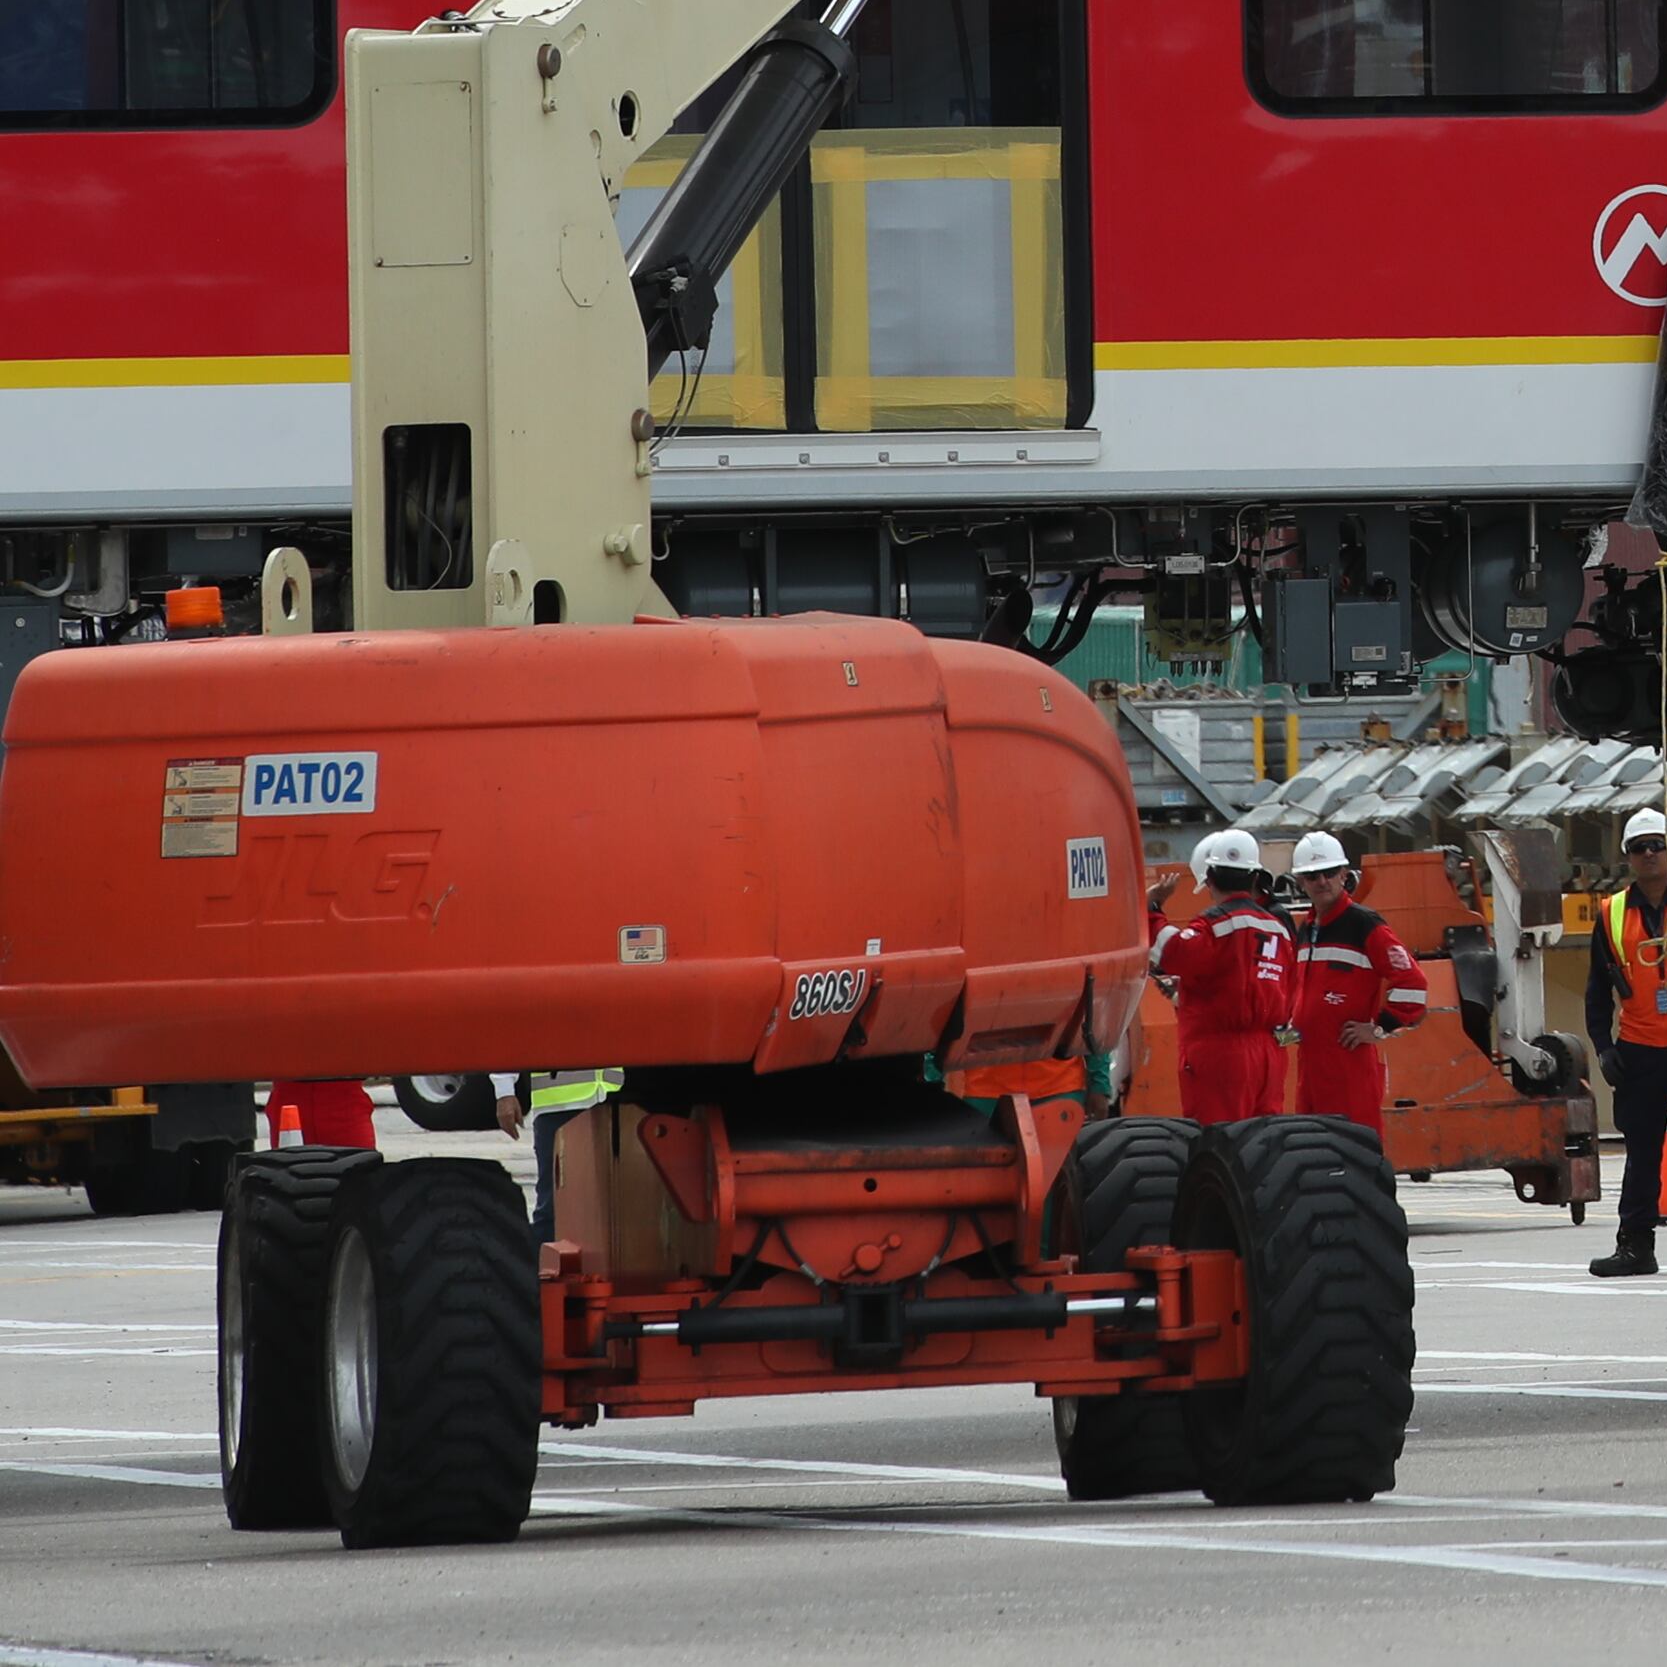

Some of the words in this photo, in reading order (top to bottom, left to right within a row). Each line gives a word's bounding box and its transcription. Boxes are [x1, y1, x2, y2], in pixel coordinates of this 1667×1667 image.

[254, 761, 364, 805] PAT02
[1070, 846, 1105, 889] PAT02
[789, 969, 866, 1020] 860SJ
